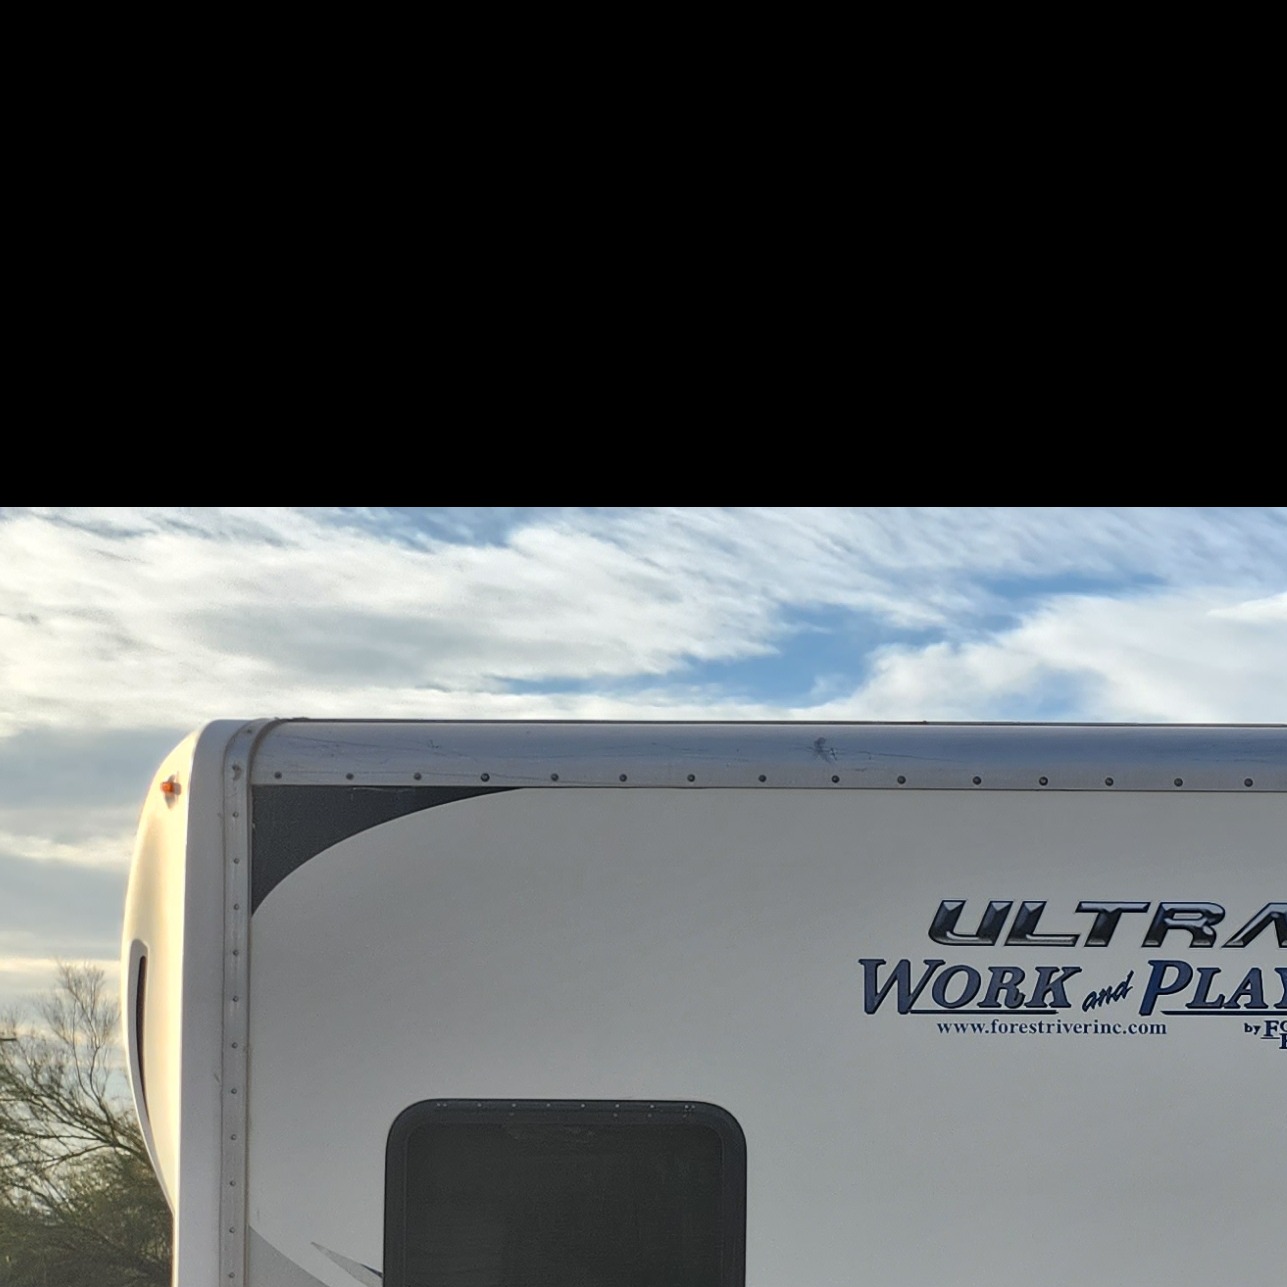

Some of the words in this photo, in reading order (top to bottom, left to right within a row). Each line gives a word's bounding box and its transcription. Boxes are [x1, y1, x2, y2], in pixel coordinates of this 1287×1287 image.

[858, 958, 1083, 1015] WORK
[1081, 969, 1135, 1013] and
[936, 1018, 1168, 1035] www.forestriverinc.com
[1243, 1022, 1261, 1035] by
